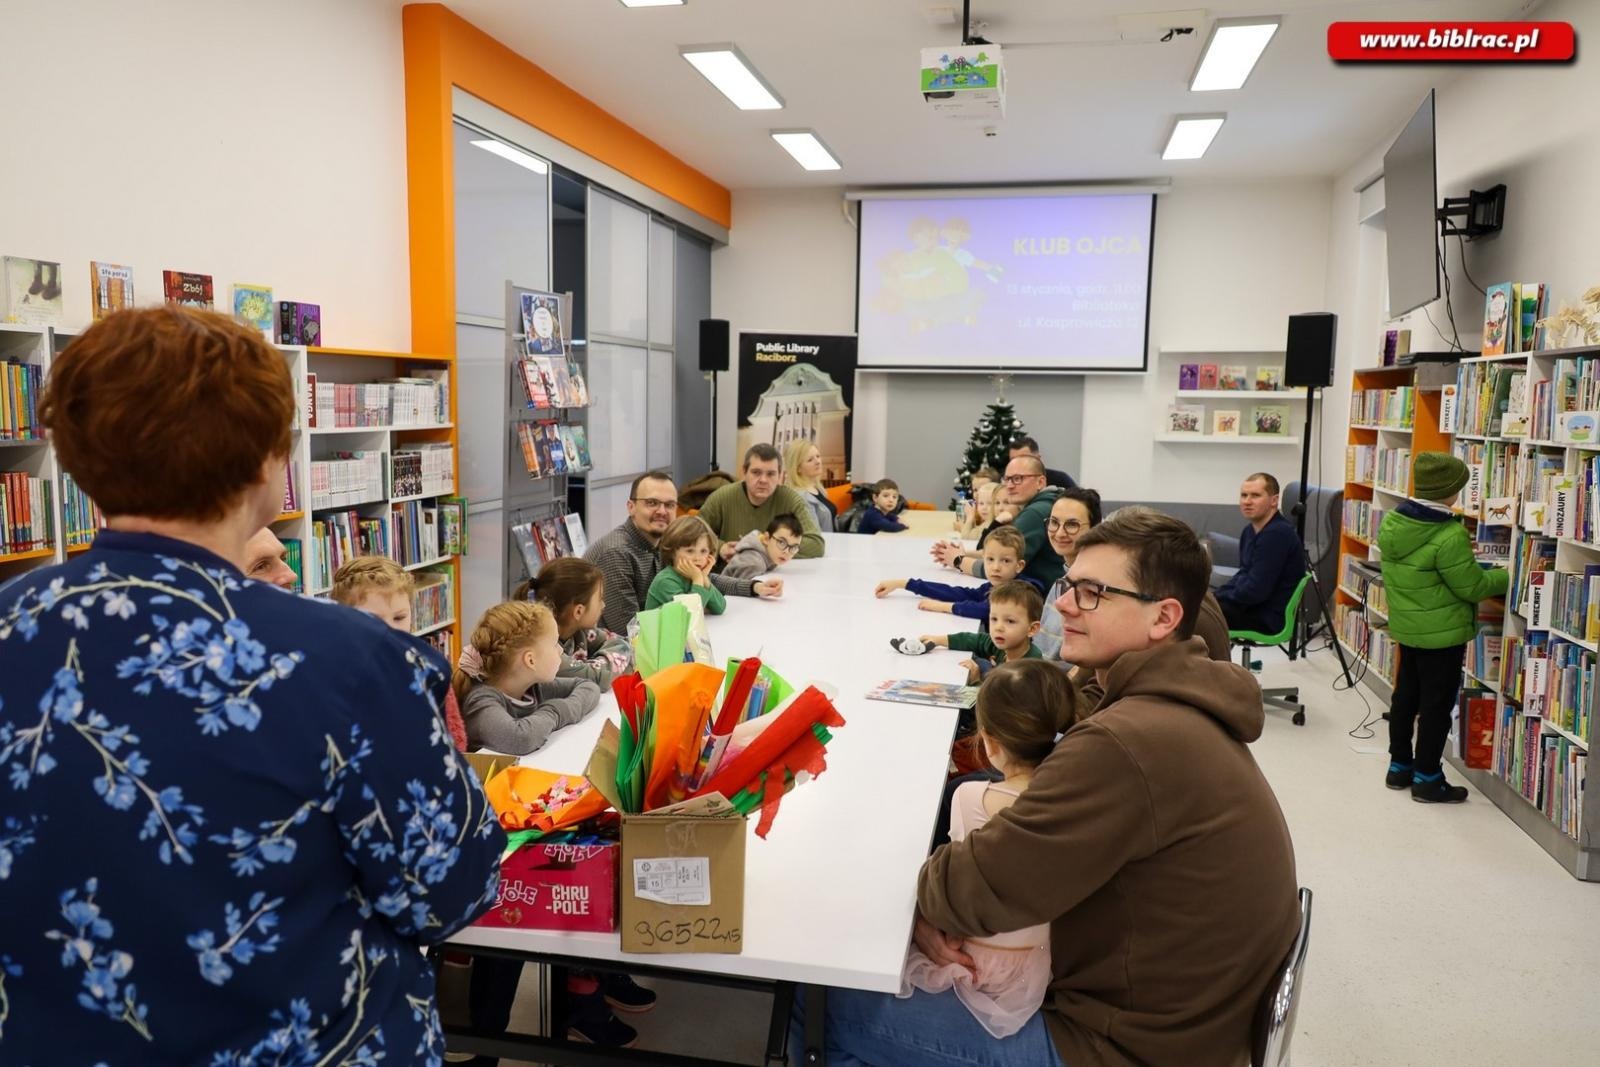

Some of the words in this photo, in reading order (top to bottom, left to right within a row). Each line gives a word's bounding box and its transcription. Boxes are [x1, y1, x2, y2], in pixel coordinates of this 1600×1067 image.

[1013, 237, 1070, 256] KLUB
[1076, 235, 1142, 255] OJCA
[756, 342, 785, 352] Public
[787, 342, 819, 355] Library
[306, 383, 314, 420] MANGA
[1469, 466, 1479, 502] ROŚLINY
[1556, 491, 1566, 537] DINOZAURY
[1533, 586, 1541, 627] MINECRAFT
[545, 900, 590, 915] -POLE
[552, 886, 589, 901] CHRU
